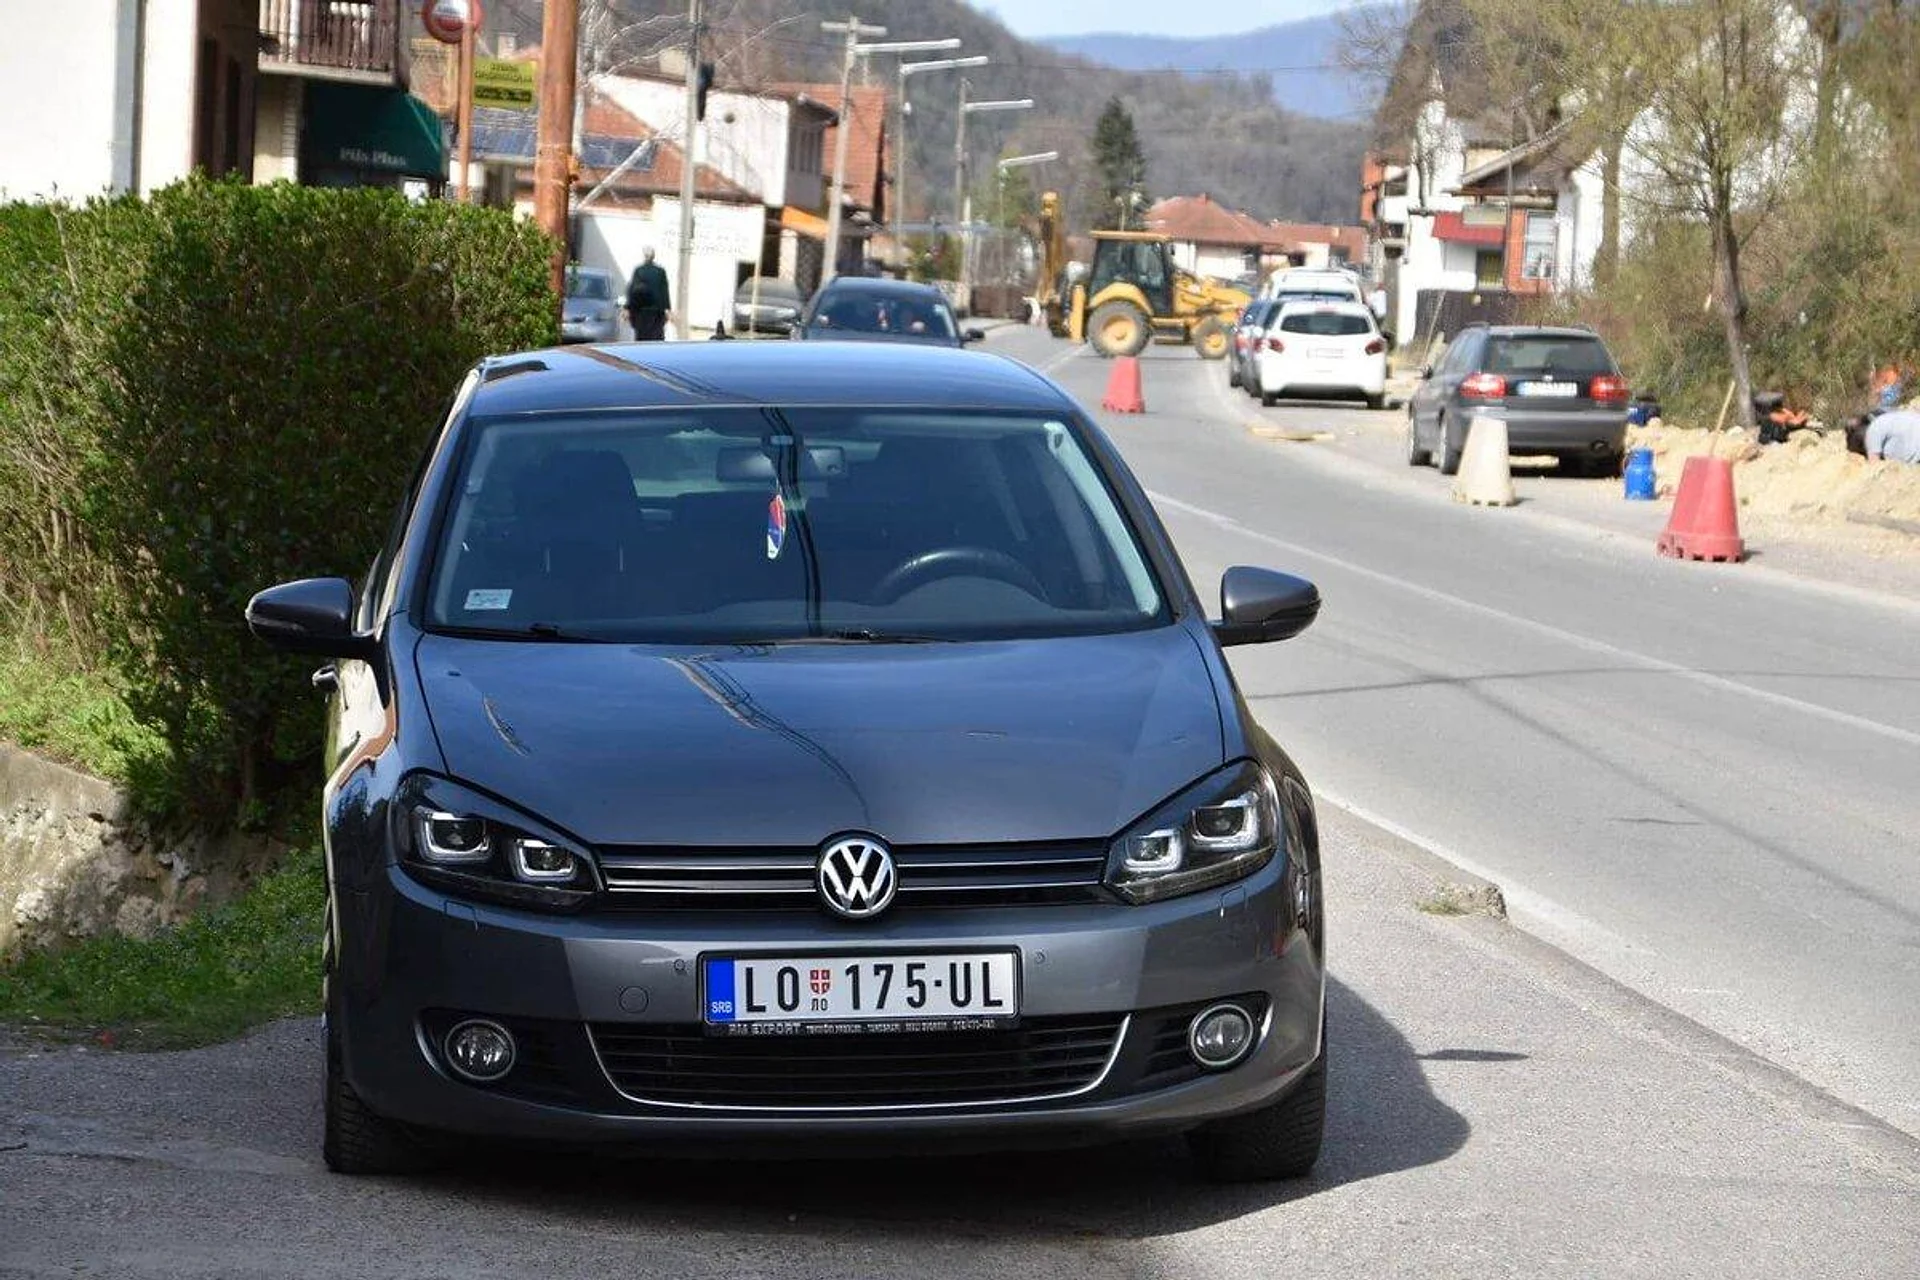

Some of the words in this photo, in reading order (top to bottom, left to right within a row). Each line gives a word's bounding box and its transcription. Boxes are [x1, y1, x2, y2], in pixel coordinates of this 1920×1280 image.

[821, 839, 893, 913] VW
[745, 966, 800, 1013] LO
[711, 1001, 733, 1014] SRB
[751, 1022, 801, 1034] EXPORT
